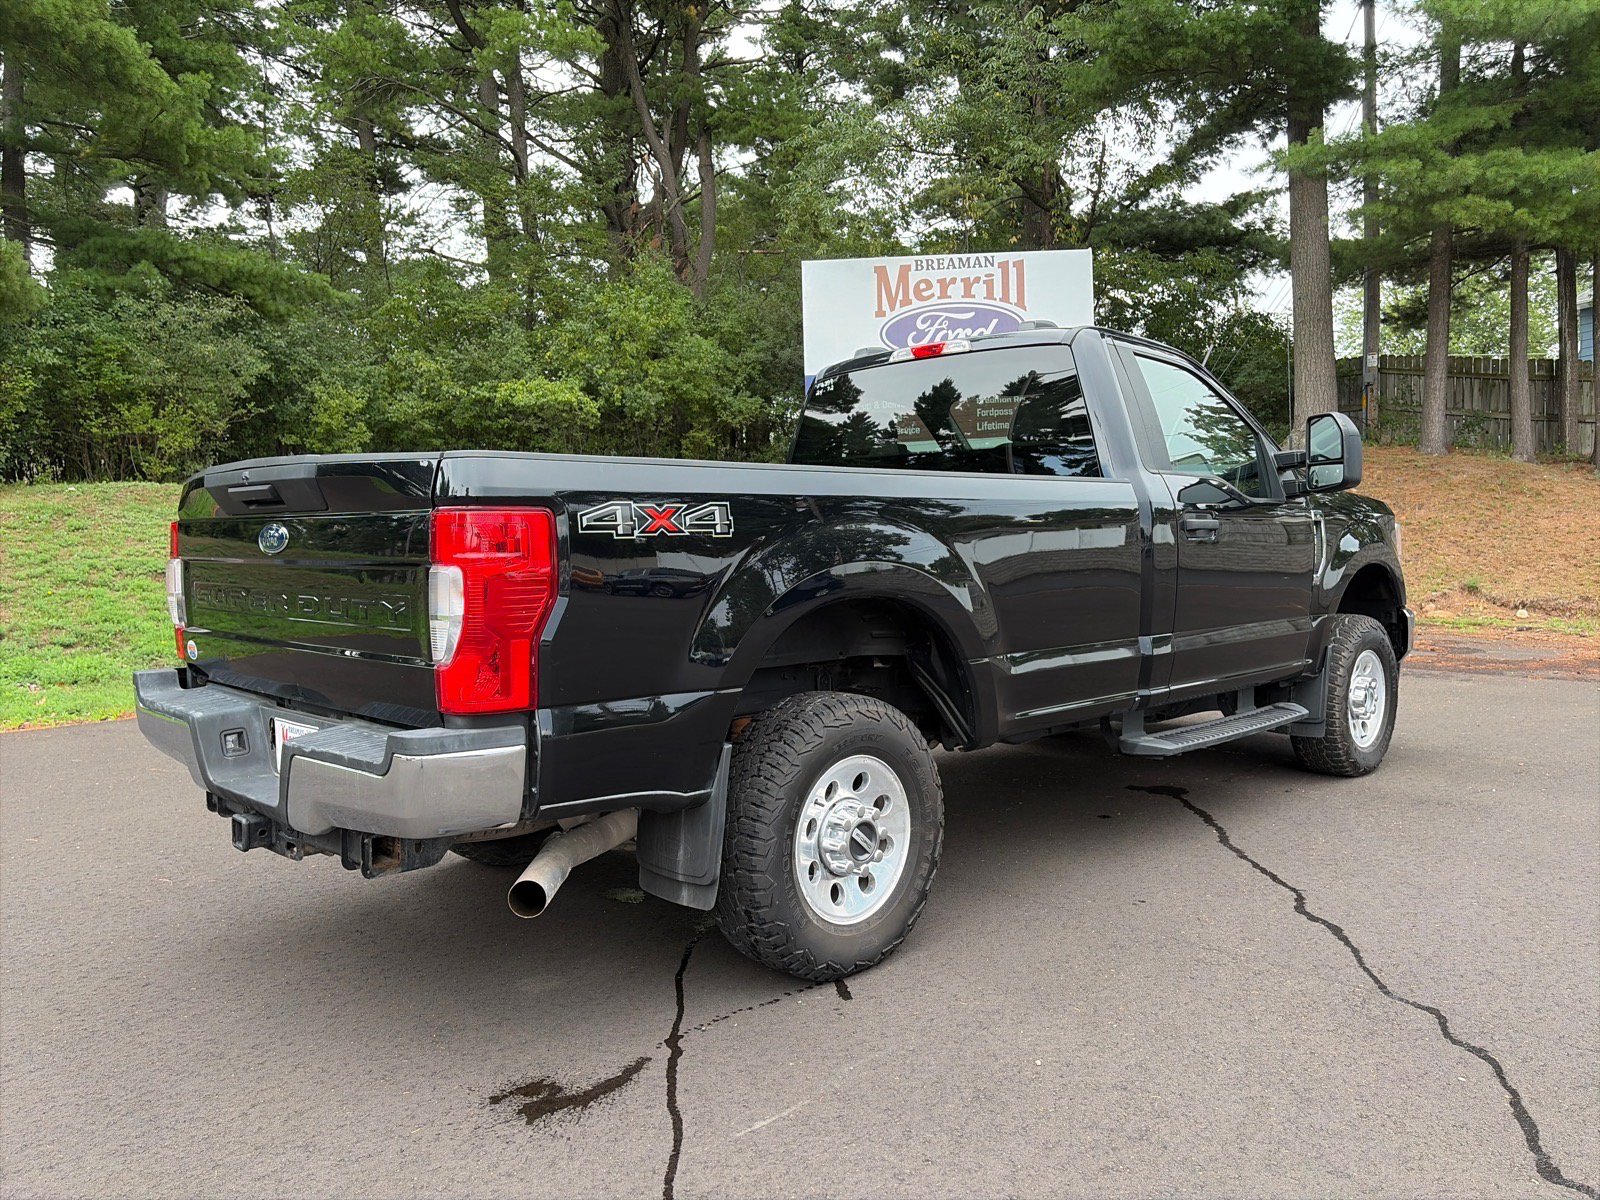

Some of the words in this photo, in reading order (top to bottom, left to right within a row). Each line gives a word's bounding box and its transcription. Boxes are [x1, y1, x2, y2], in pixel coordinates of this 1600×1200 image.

[914, 255, 995, 271] BREAMAN
[874, 259, 1028, 318] Merrill
[907, 311, 999, 346] Ford
[976, 407, 1014, 418] Fordpass
[976, 421, 1010, 431] Lifetime
[297, 595, 406, 623] DUTY
